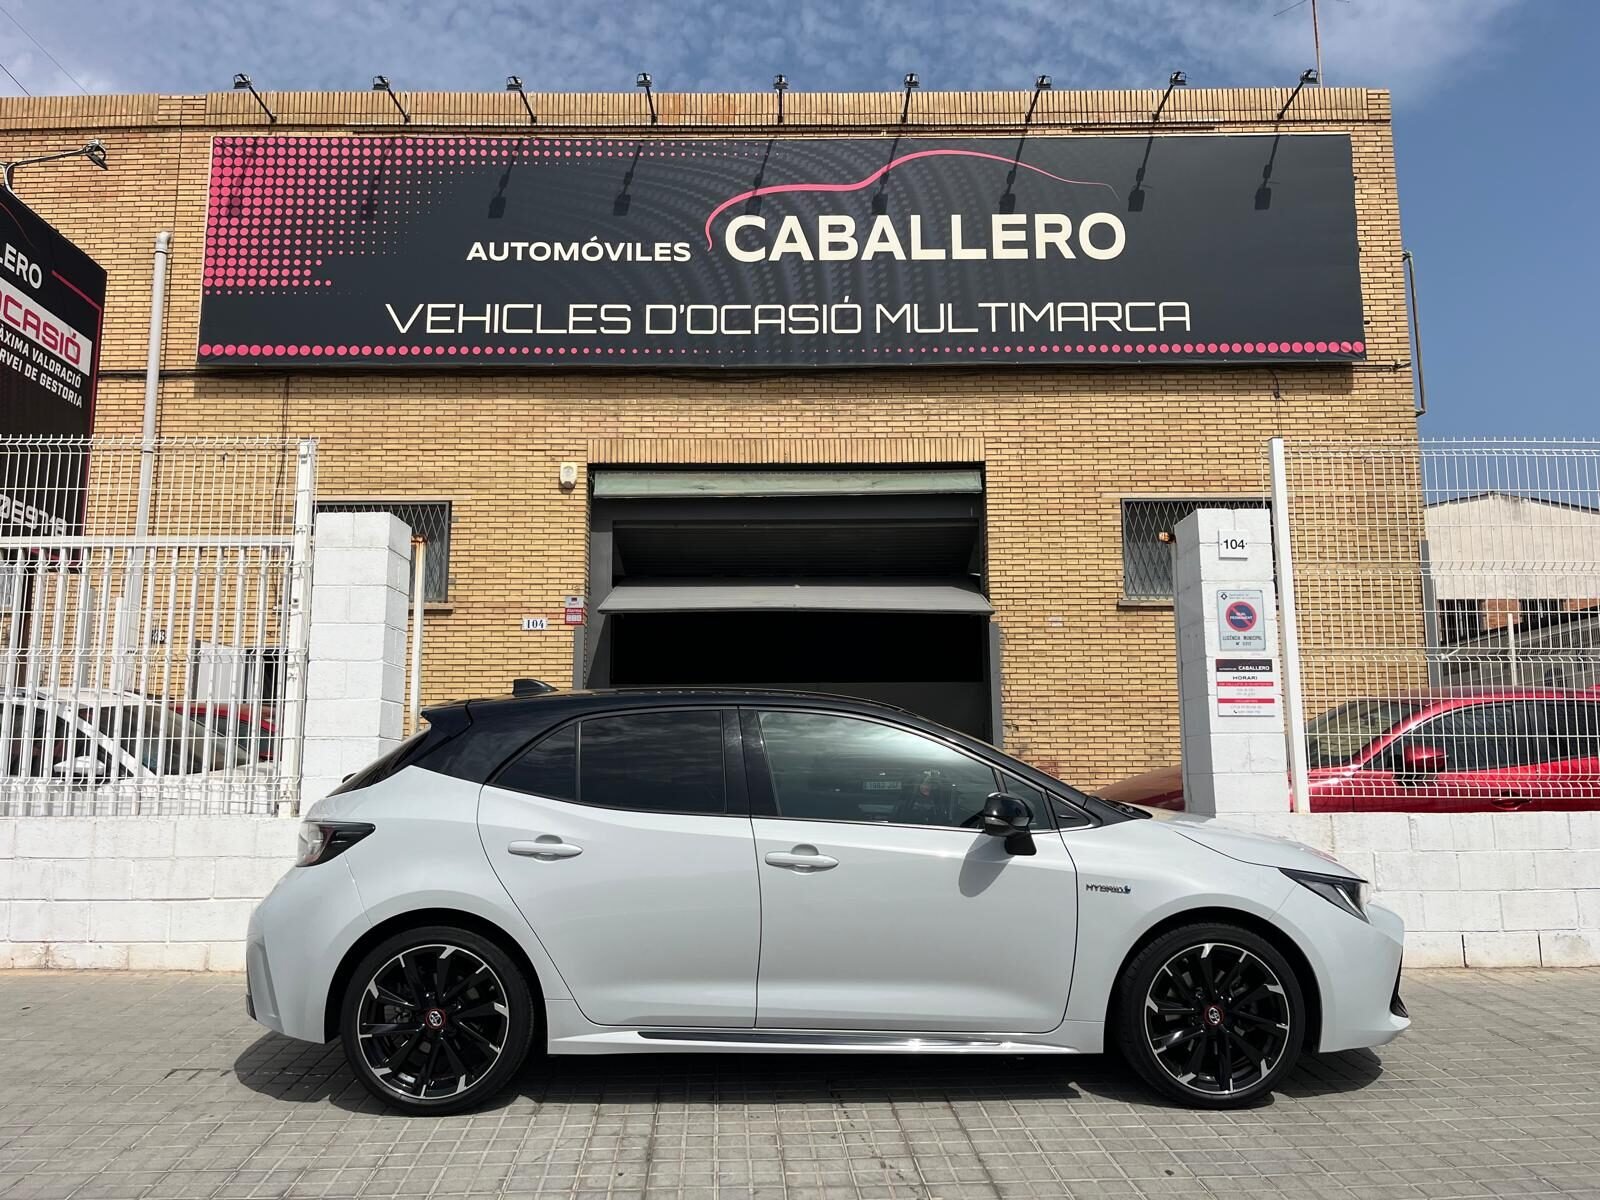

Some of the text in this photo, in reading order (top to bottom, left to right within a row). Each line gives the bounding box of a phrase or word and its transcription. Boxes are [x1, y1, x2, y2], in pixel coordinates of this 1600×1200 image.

[466, 212, 1126, 262] AUTOMÓVILES CABALLERO
[0, 242, 43, 290] ERO
[0, 289, 81, 366] CASIÓ
[385, 295, 1192, 335] VEHICLES D'OCASIÓ MULTIMARCA
[24, 362, 37, 382] DE
[39, 372, 83, 409] GESTORIA
[32, 347, 82, 390] VALORACIÓ
[1223, 539, 1246, 550] 104
[527, 619, 544, 629] 104
